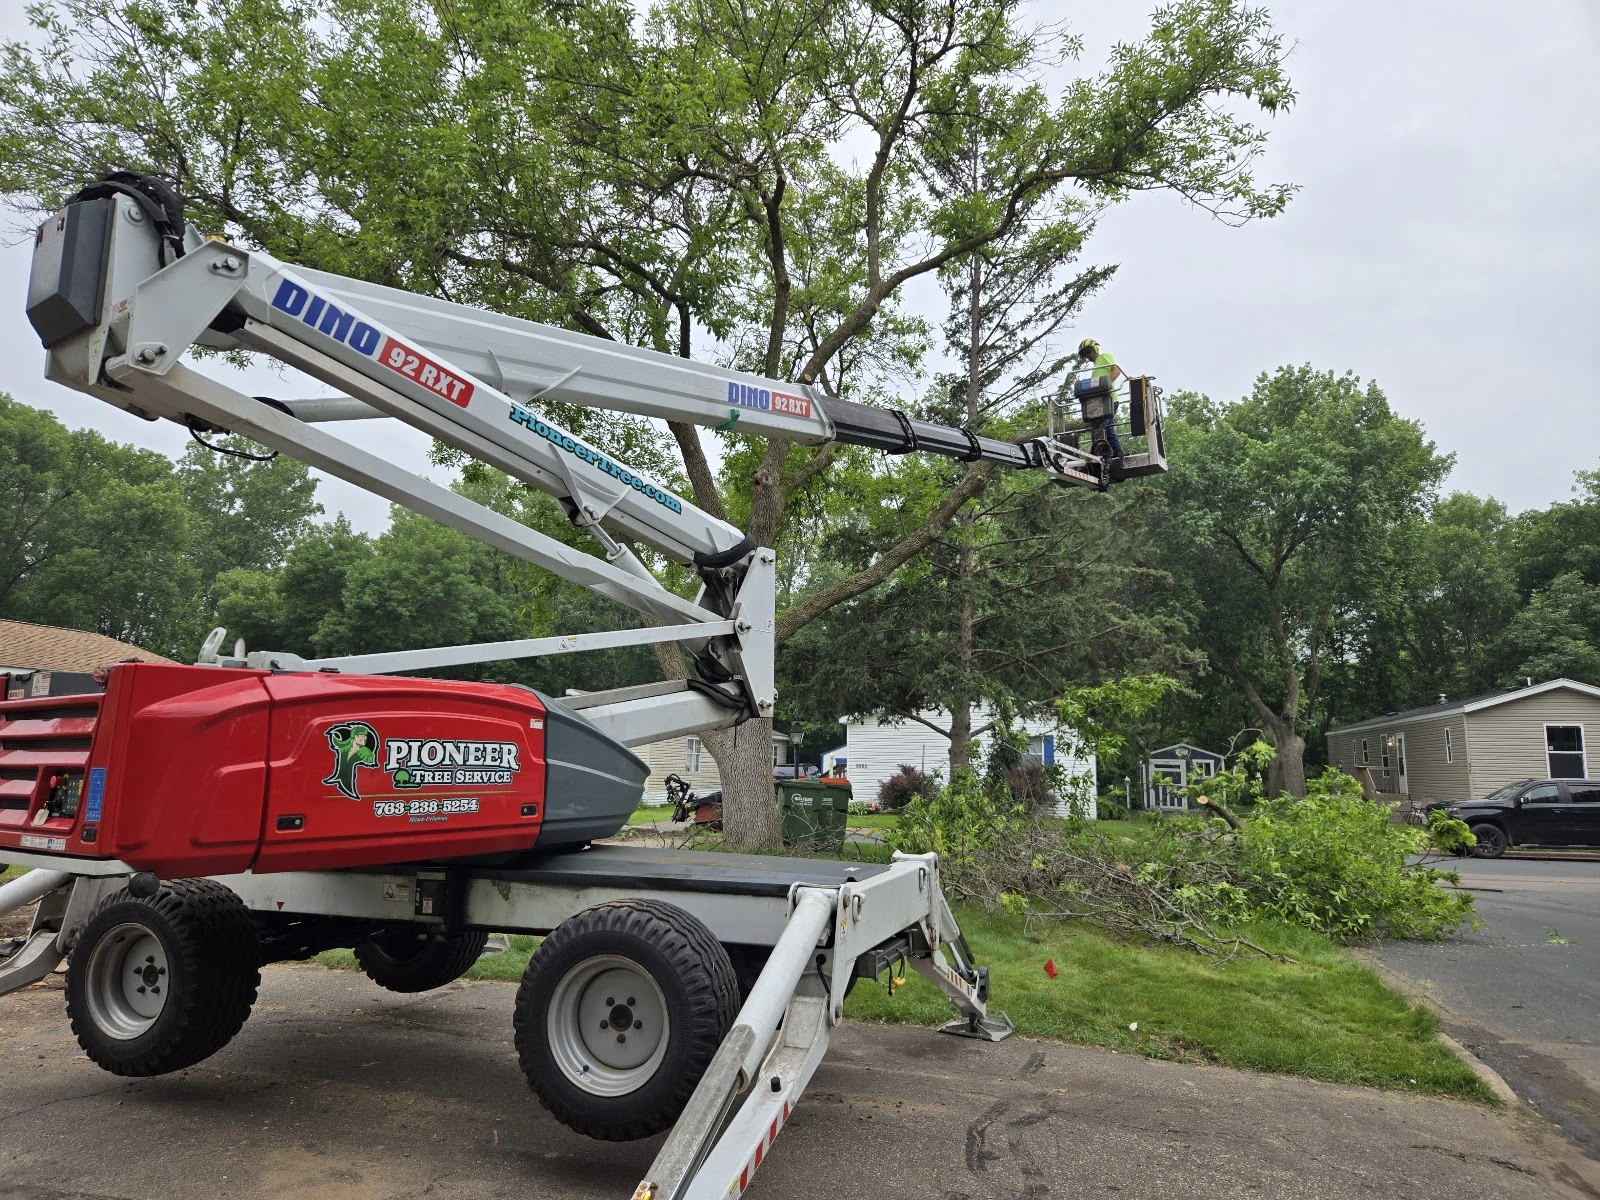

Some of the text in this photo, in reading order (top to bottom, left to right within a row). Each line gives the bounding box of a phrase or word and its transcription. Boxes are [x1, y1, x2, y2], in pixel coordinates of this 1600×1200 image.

[271, 278, 466, 401] DINO 92 RXT
[728, 381, 807, 415] DINO 92 RXT
[509, 401, 682, 516] PioneerTree.com
[385, 739, 520, 772] PIONEER
[411, 769, 512, 784] TREE SERVICE
[374, 798, 478, 817] 763-238-5254
